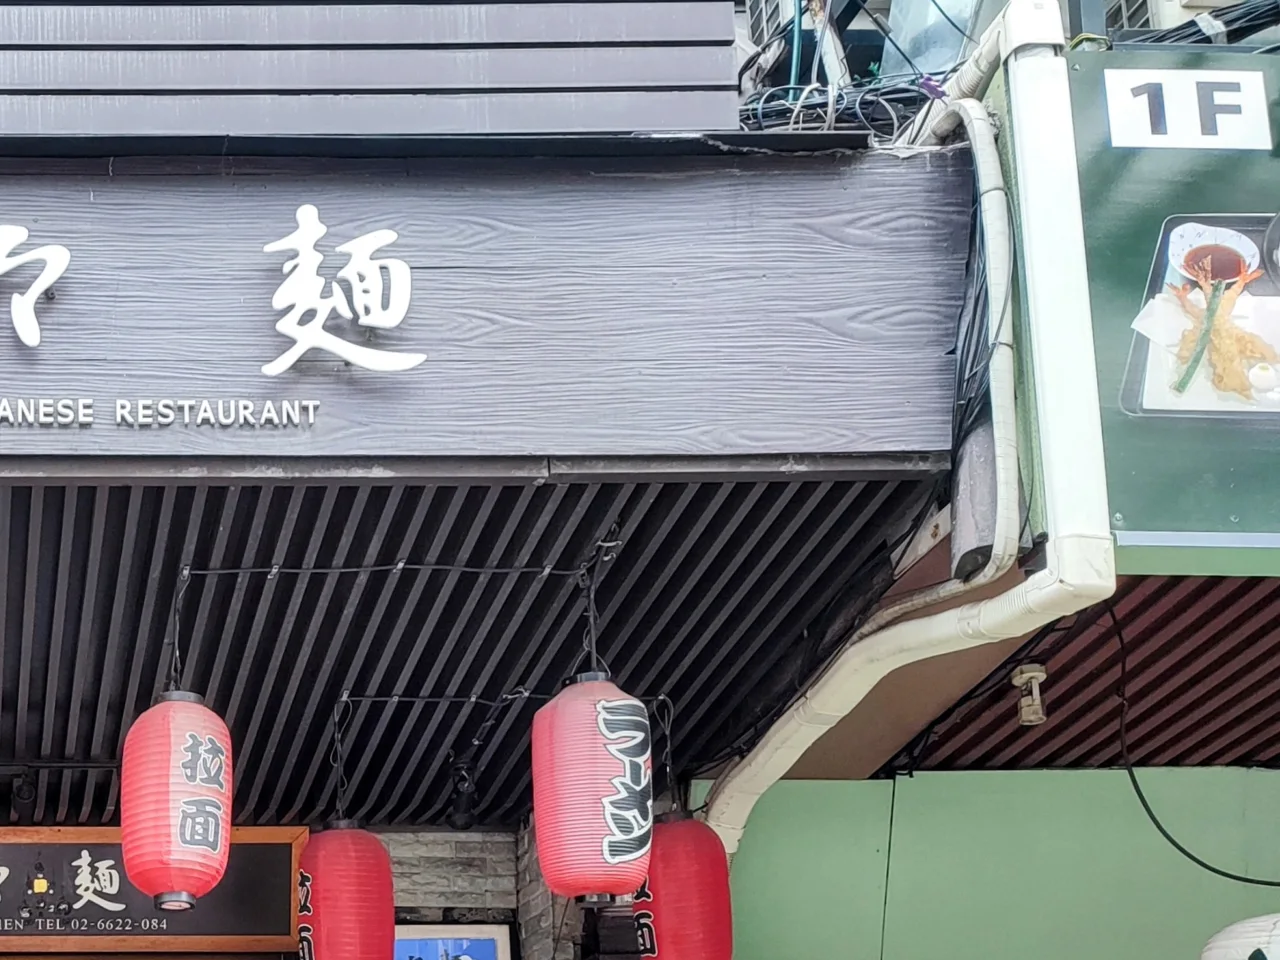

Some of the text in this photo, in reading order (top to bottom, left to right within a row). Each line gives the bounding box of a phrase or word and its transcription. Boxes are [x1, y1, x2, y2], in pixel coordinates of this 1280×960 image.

[1130, 81, 1243, 137] 1F
[115, 399, 321, 427] RESTAURANT
[178, 731, 226, 855] 拉面
[37, 918, 66, 930] TEL
[71, 918, 168, 930] 02-6622-084
